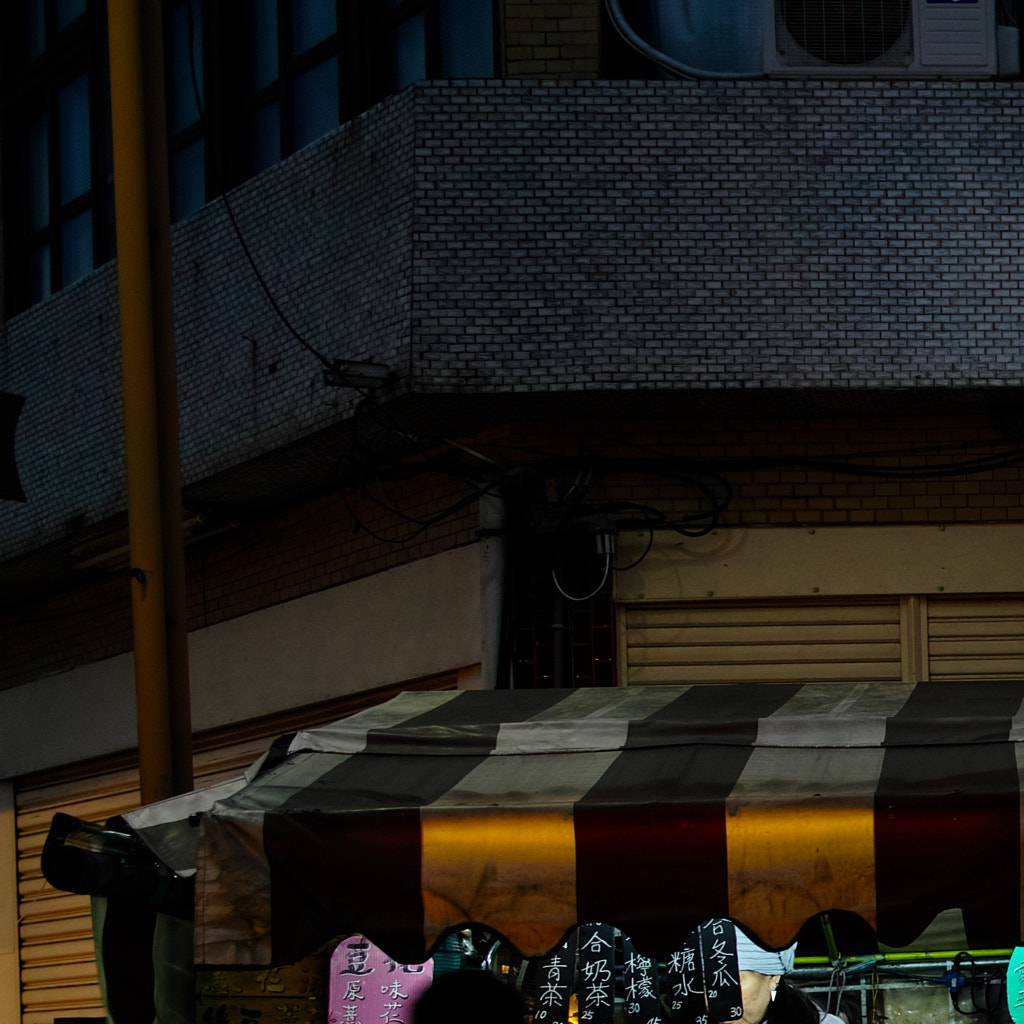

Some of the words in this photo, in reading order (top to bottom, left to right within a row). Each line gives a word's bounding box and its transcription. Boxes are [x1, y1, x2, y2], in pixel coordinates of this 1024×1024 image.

[580, 921, 612, 1009] 合奶茶
[342, 979, 409, 1001] 原味
[708, 988, 718, 999] 20
[628, 1002, 641, 1014] 30
[671, 1000, 683, 1010] 25
[533, 1010, 547, 1020] 10
[580, 1010, 595, 1020] 25
[729, 1006, 744, 1018] 30
